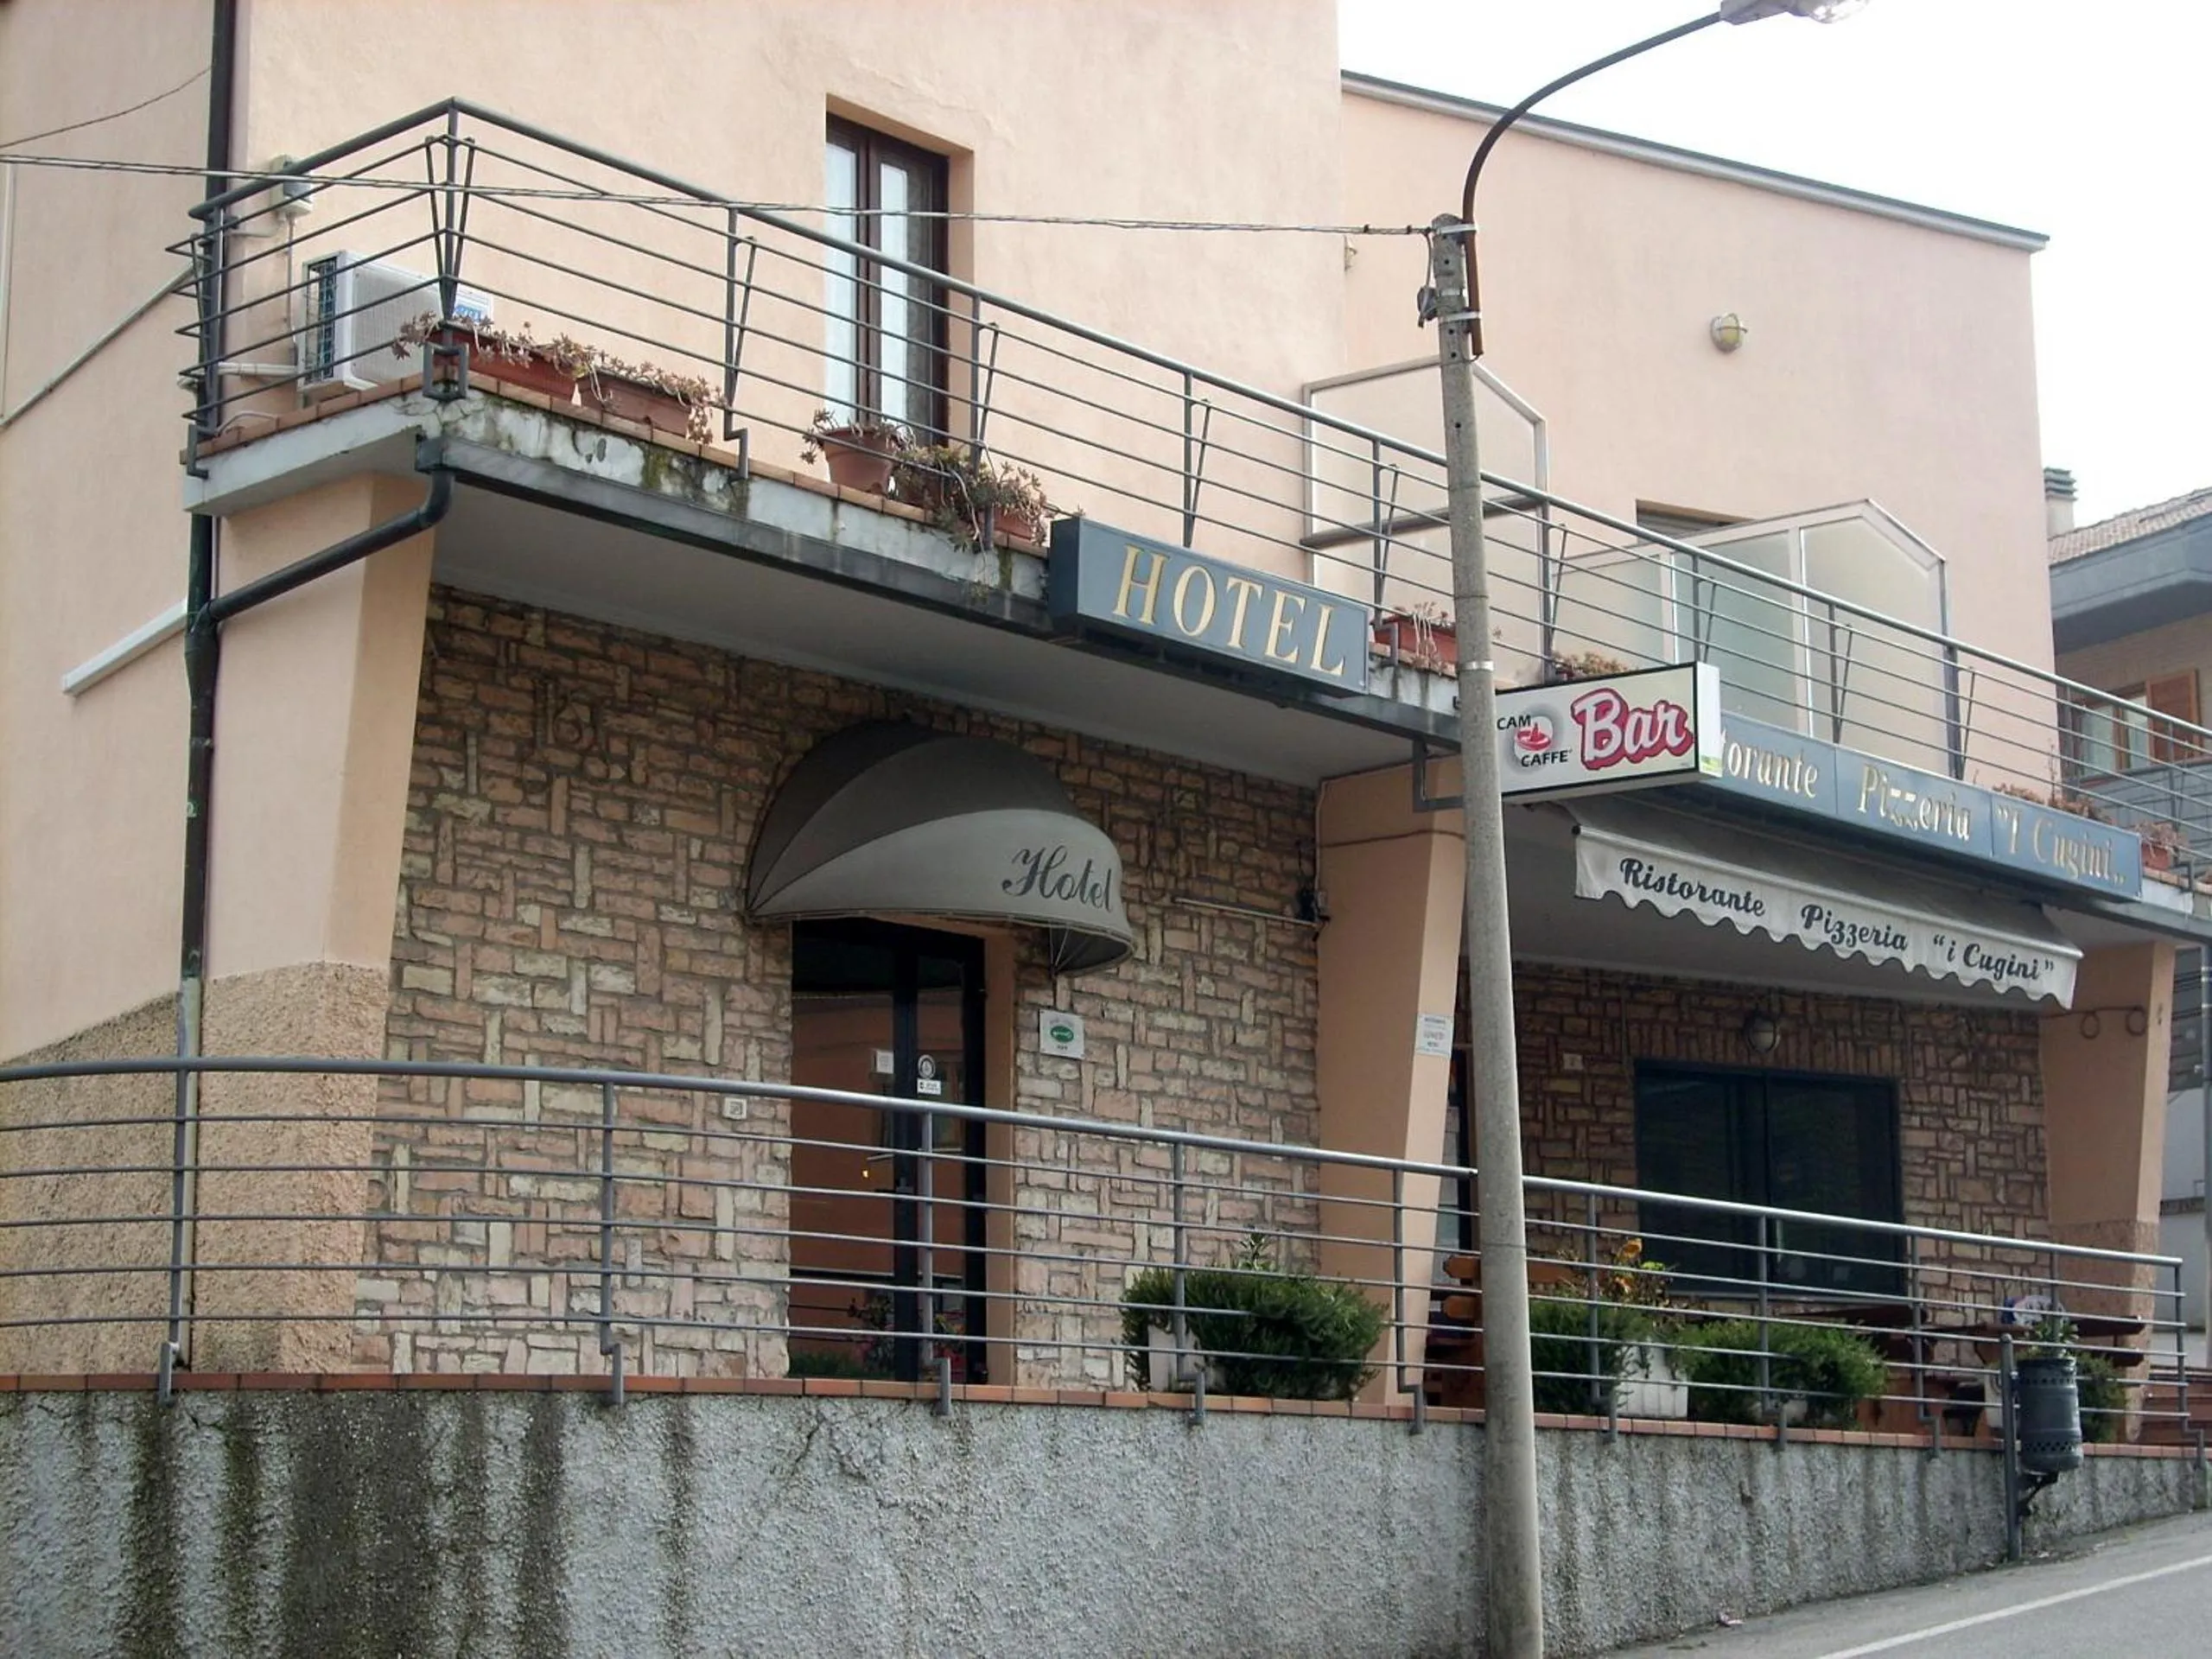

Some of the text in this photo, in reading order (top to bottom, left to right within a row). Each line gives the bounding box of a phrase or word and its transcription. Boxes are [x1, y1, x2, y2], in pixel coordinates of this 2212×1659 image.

[1112, 543, 1347, 677] HOTEL
[1497, 714, 1532, 731] CAM
[1570, 688, 1695, 771] Bar
[1720, 727, 1818, 798] orante
[1858, 762, 1971, 842] Pizzeria
[1002, 845, 1111, 913] Hotel
[1620, 857, 1765, 917] Ristorante
[1801, 904, 1908, 951] Pizzeria
